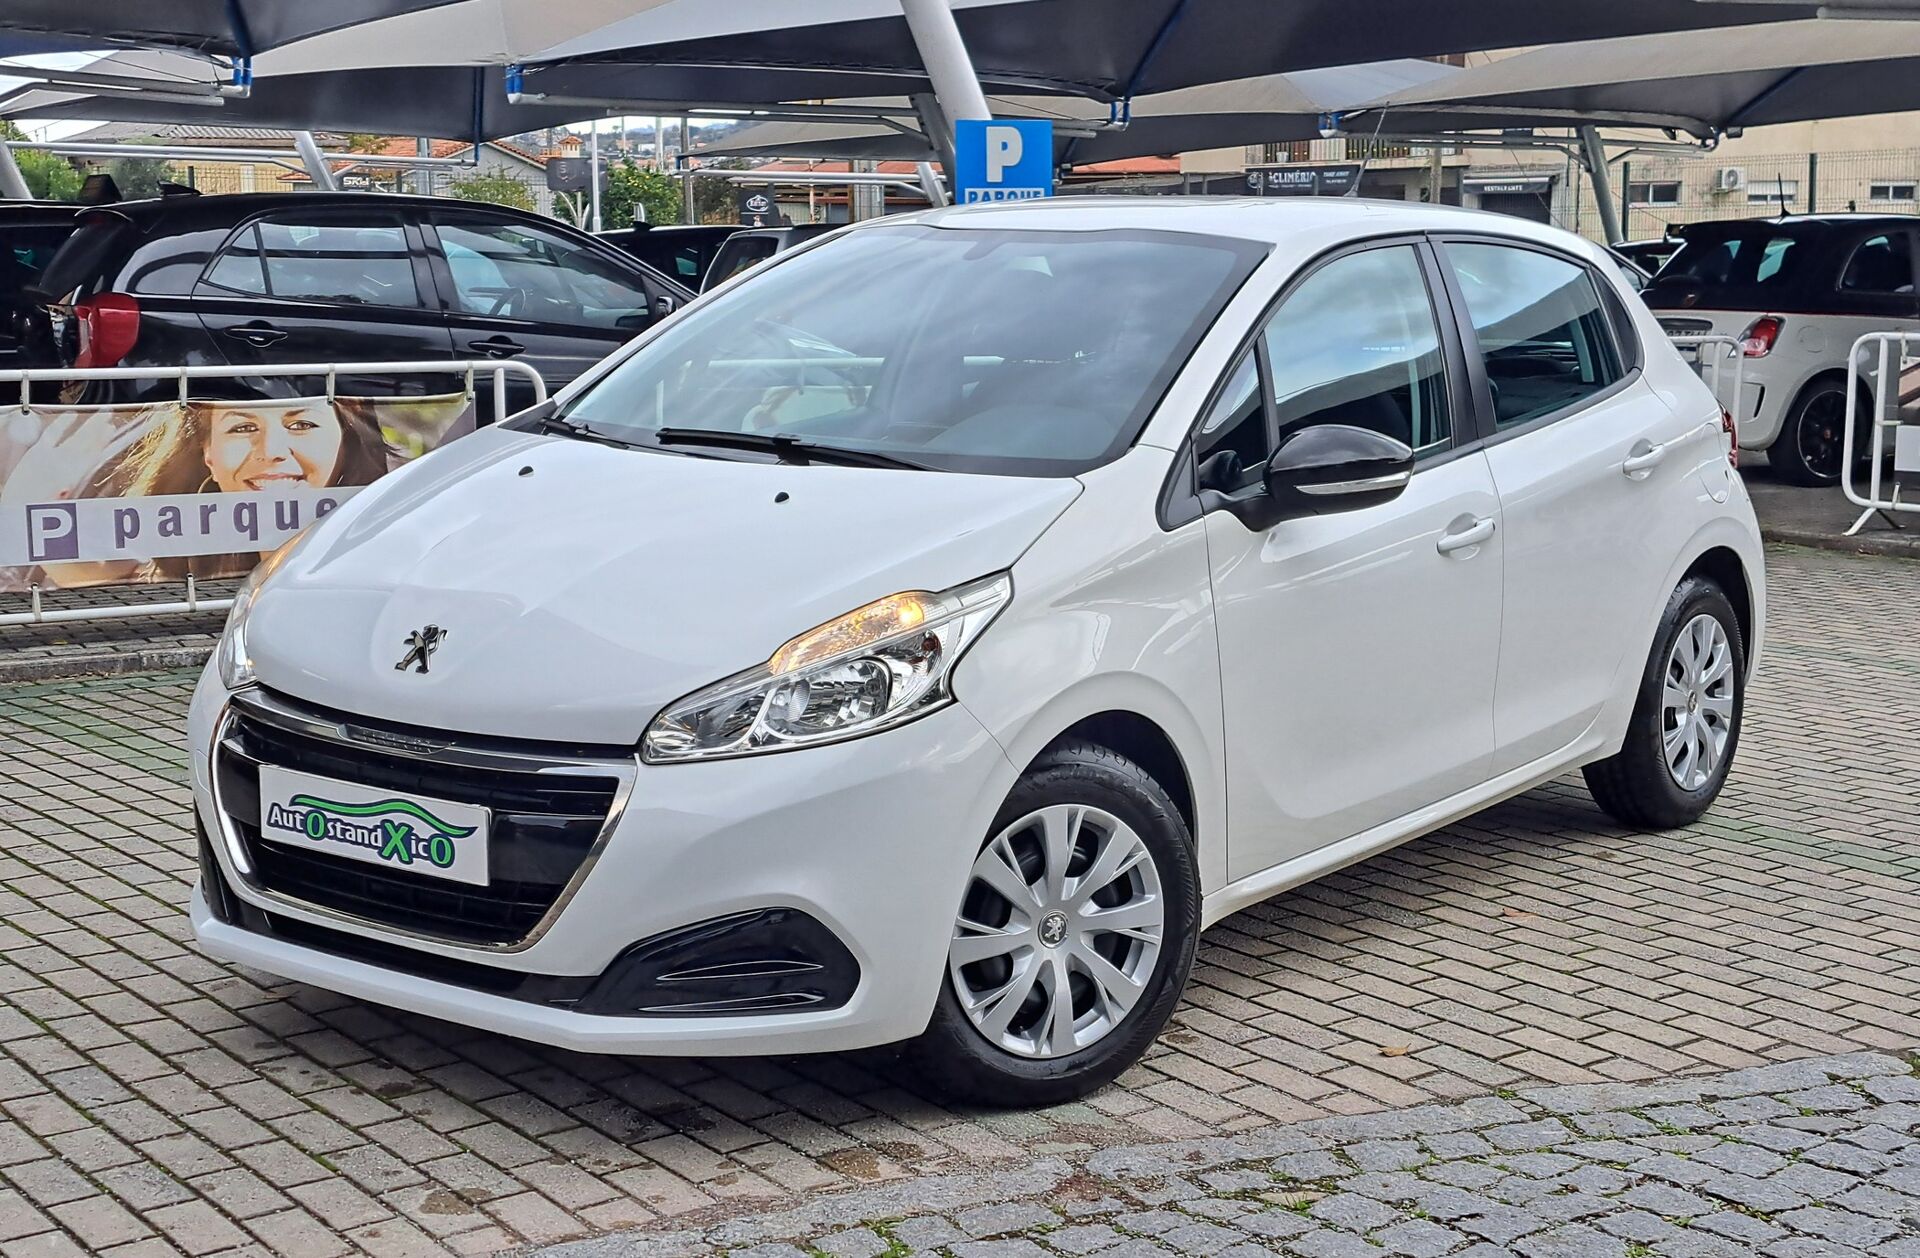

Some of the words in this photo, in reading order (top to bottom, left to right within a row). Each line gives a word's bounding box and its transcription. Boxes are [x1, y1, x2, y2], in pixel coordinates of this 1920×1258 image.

[986, 126, 1023, 183] P
[30, 507, 77, 559] P
[114, 497, 338, 549] parque
